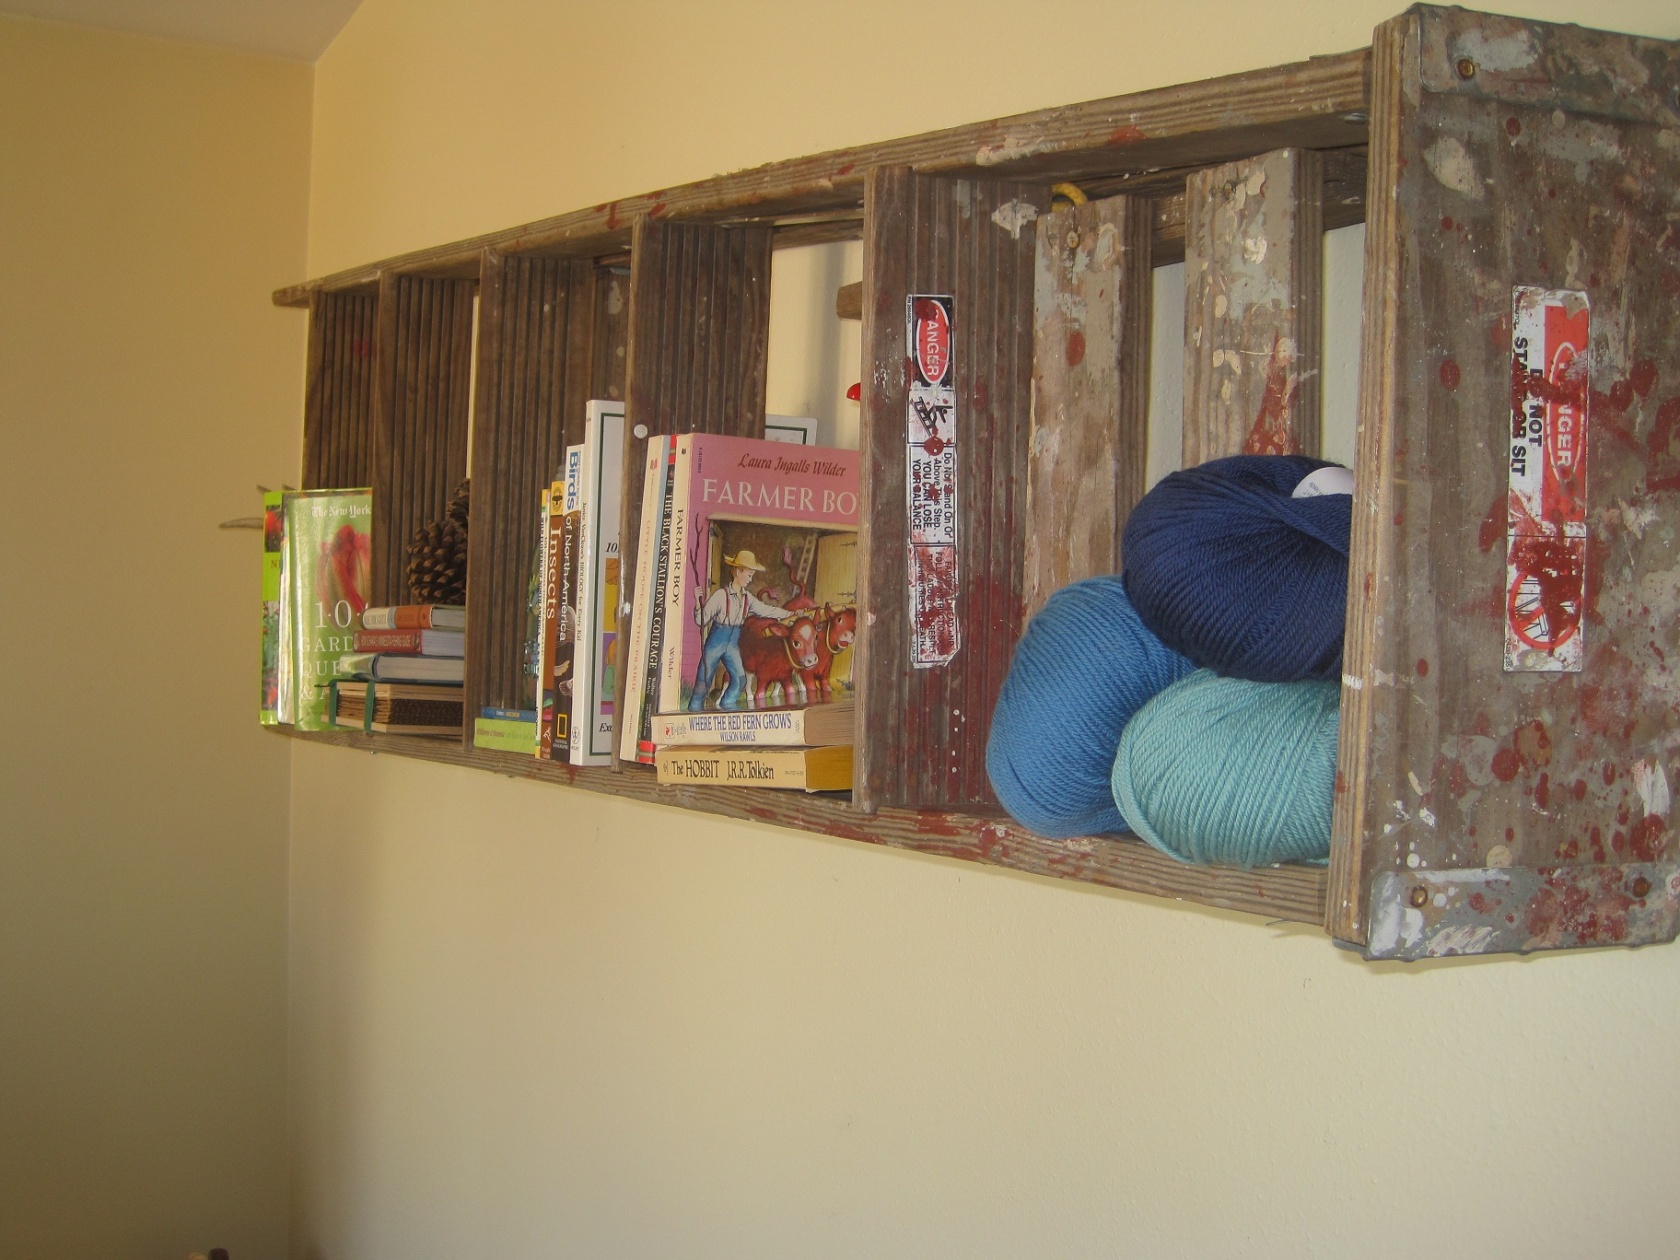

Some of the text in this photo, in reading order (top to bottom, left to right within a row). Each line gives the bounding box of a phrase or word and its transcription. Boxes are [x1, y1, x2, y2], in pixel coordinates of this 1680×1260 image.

[926, 309, 940, 376] ANGER
[1528, 404, 1543, 448] NOT
[737, 453, 847, 477] Laura Ingalls Wilder
[922, 460, 932, 479] YOU
[943, 452, 953, 464] Do
[1510, 445, 1527, 478] SIT
[933, 458, 942, 486] Above
[663, 492, 673, 515] THE
[702, 478, 860, 516] FARMER BO
[912, 485, 922, 530] ALANCE
[943, 484, 953, 509] Sand
[311, 504, 372, 519] The New York
[922, 503, 932, 528] LOSE
[944, 511, 953, 523] On
[559, 451, 579, 641] Birds of North America
[660, 518, 670, 552] BLACK
[672, 508, 684, 607] FARMER BOY
[546, 526, 562, 620] Insects
[654, 555, 668, 614] STALLION'S
[299, 636, 354, 653] GARD
[648, 617, 662, 670] COURAGE
[300, 660, 343, 677] QUE
[667, 646, 676, 680] Wilder
[688, 715, 713, 732] WHERE
[713, 715, 727, 731] THE
[727, 714, 741, 731] RED
[742, 714, 762, 730] FERN
[763, 712, 792, 730] GROWS
[719, 731, 756, 743] WILSON RAWLS
[671, 760, 684, 776] The
[685, 758, 720, 779] HOBBIT
